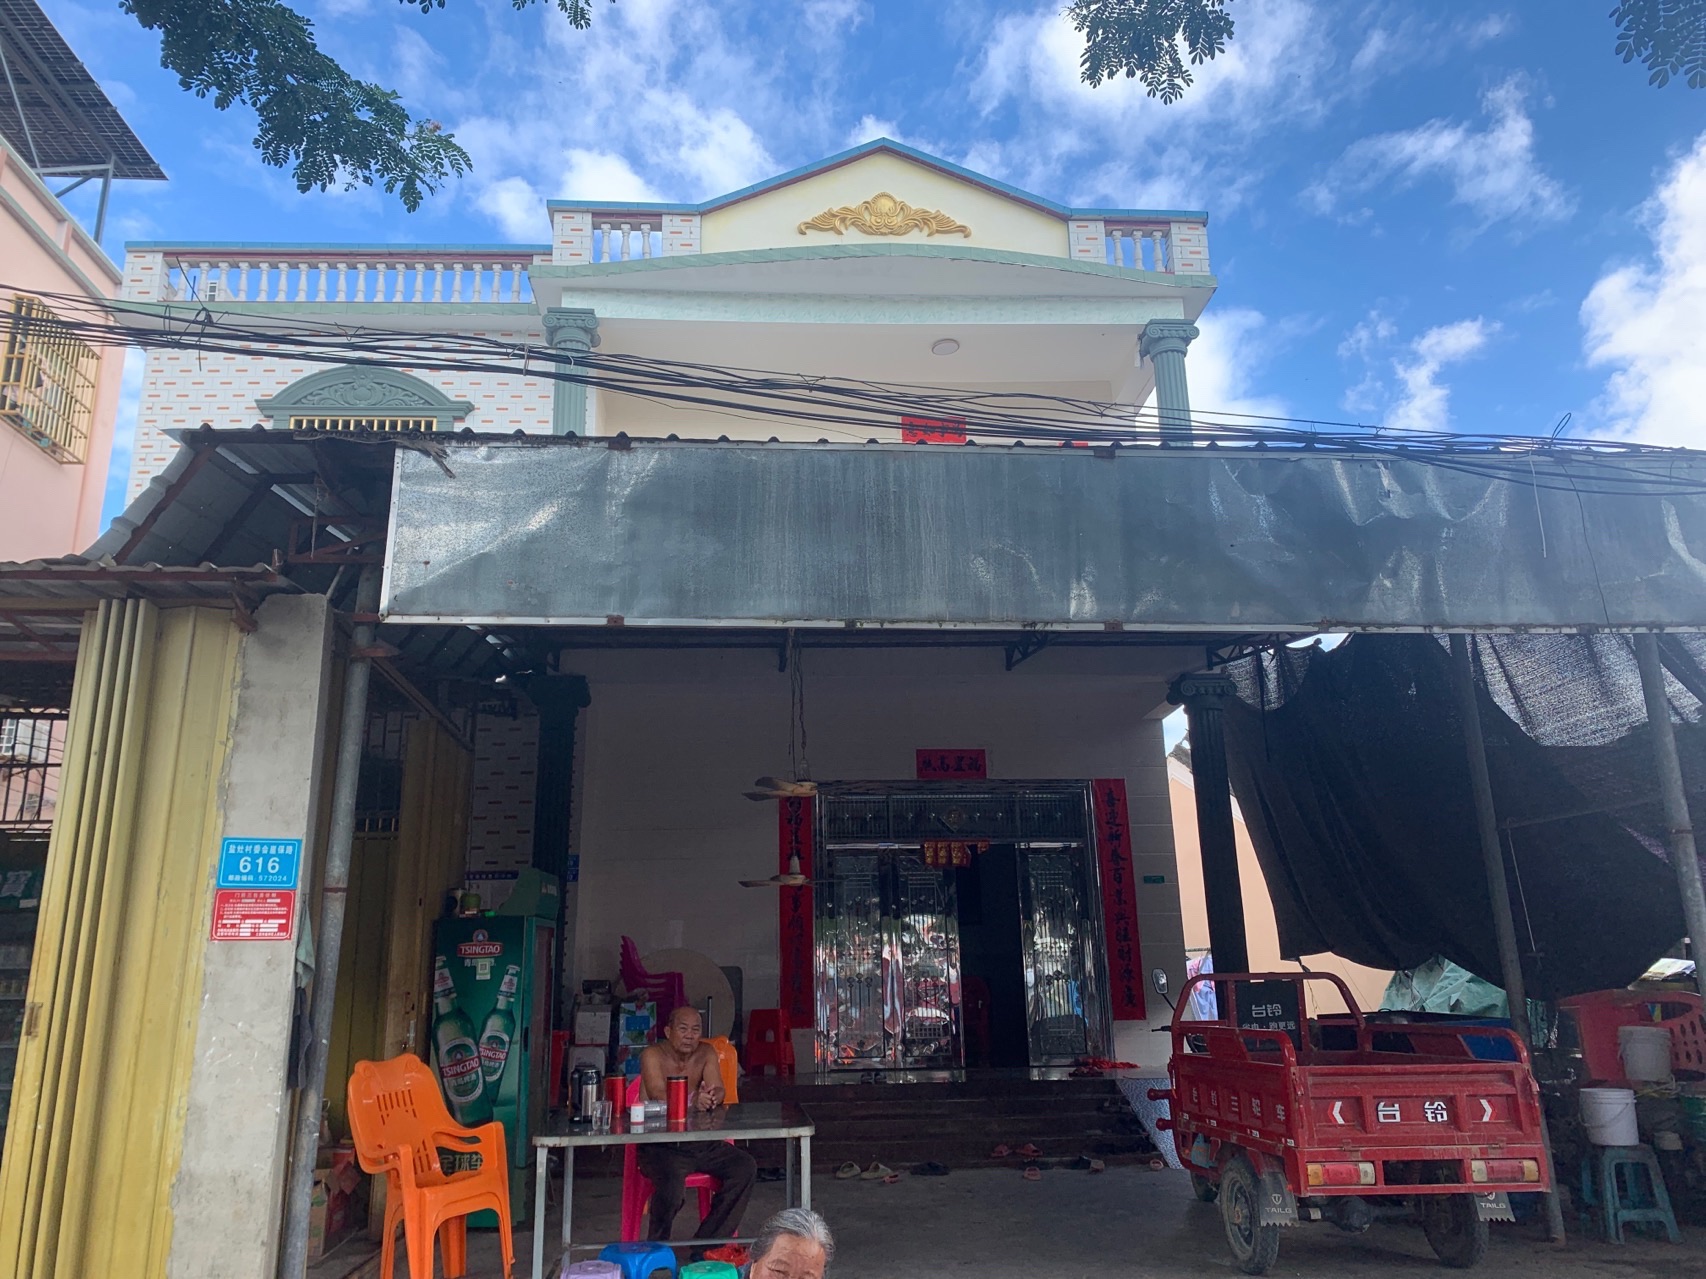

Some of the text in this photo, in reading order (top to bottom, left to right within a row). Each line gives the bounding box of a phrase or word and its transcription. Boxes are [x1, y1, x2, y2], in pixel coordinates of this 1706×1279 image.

[239, 856, 280, 874] 616
[461, 945, 500, 954] TSINGTAO
[1251, 1003, 1283, 1018] 台铃
[442, 1057, 480, 1077] TSINGTAO
[1377, 1101, 1448, 1123] 台铃
